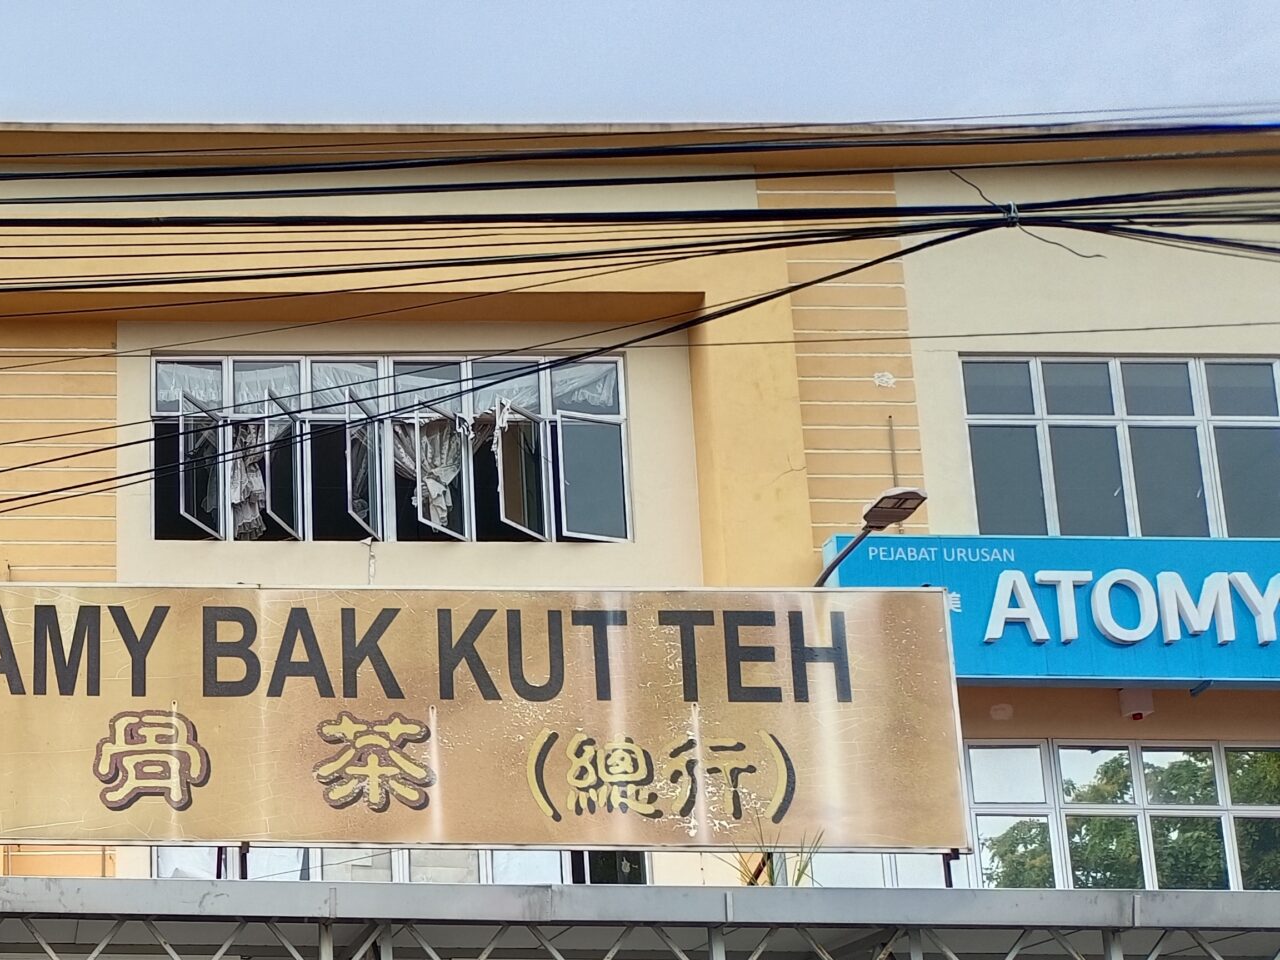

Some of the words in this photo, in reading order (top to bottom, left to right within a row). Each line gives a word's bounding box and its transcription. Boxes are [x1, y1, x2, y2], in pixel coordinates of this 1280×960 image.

[868, 547, 938, 562] PEJABAT
[943, 547, 1016, 563] URUSAN
[982, 568, 1280, 646] ATOMY
[202, 605, 406, 700] BAK
[436, 607, 628, 702] KUT
[657, 610, 853, 704] TEH
